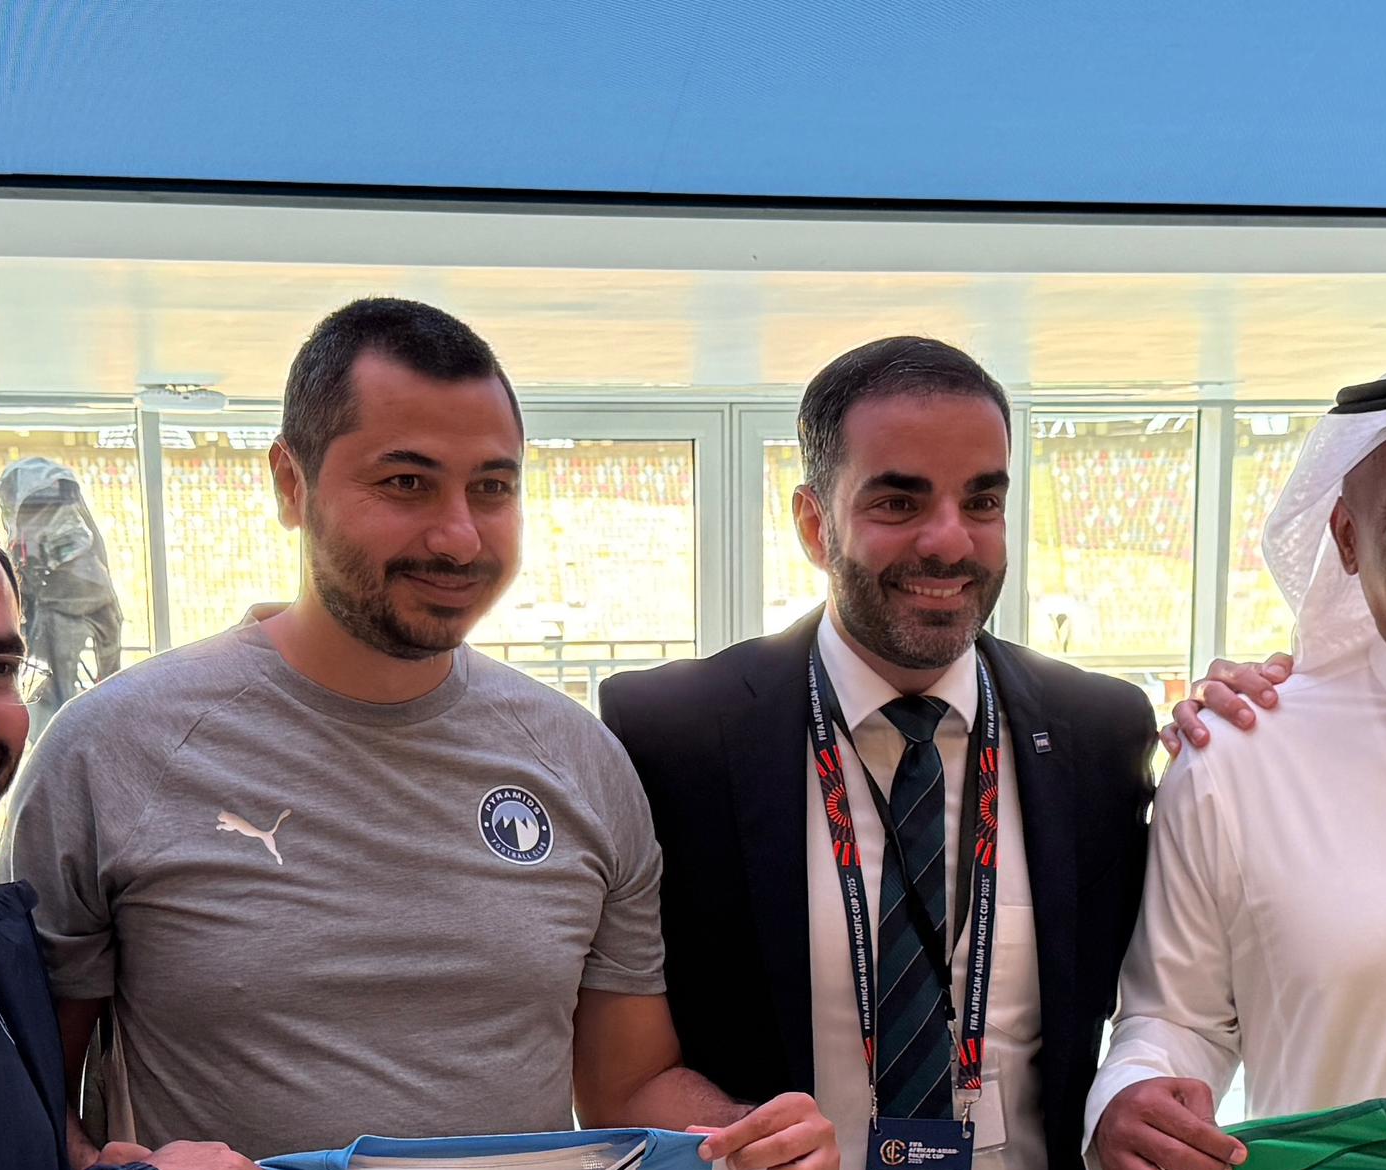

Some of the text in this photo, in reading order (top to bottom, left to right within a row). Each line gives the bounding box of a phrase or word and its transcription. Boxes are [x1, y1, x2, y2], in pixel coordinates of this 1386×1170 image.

[485, 790, 542, 816] PYRAMIDS
[491, 838, 532, 860] FOOTBALL
[850, 897, 861, 914] CUP
[979, 897, 989, 915] CUP
